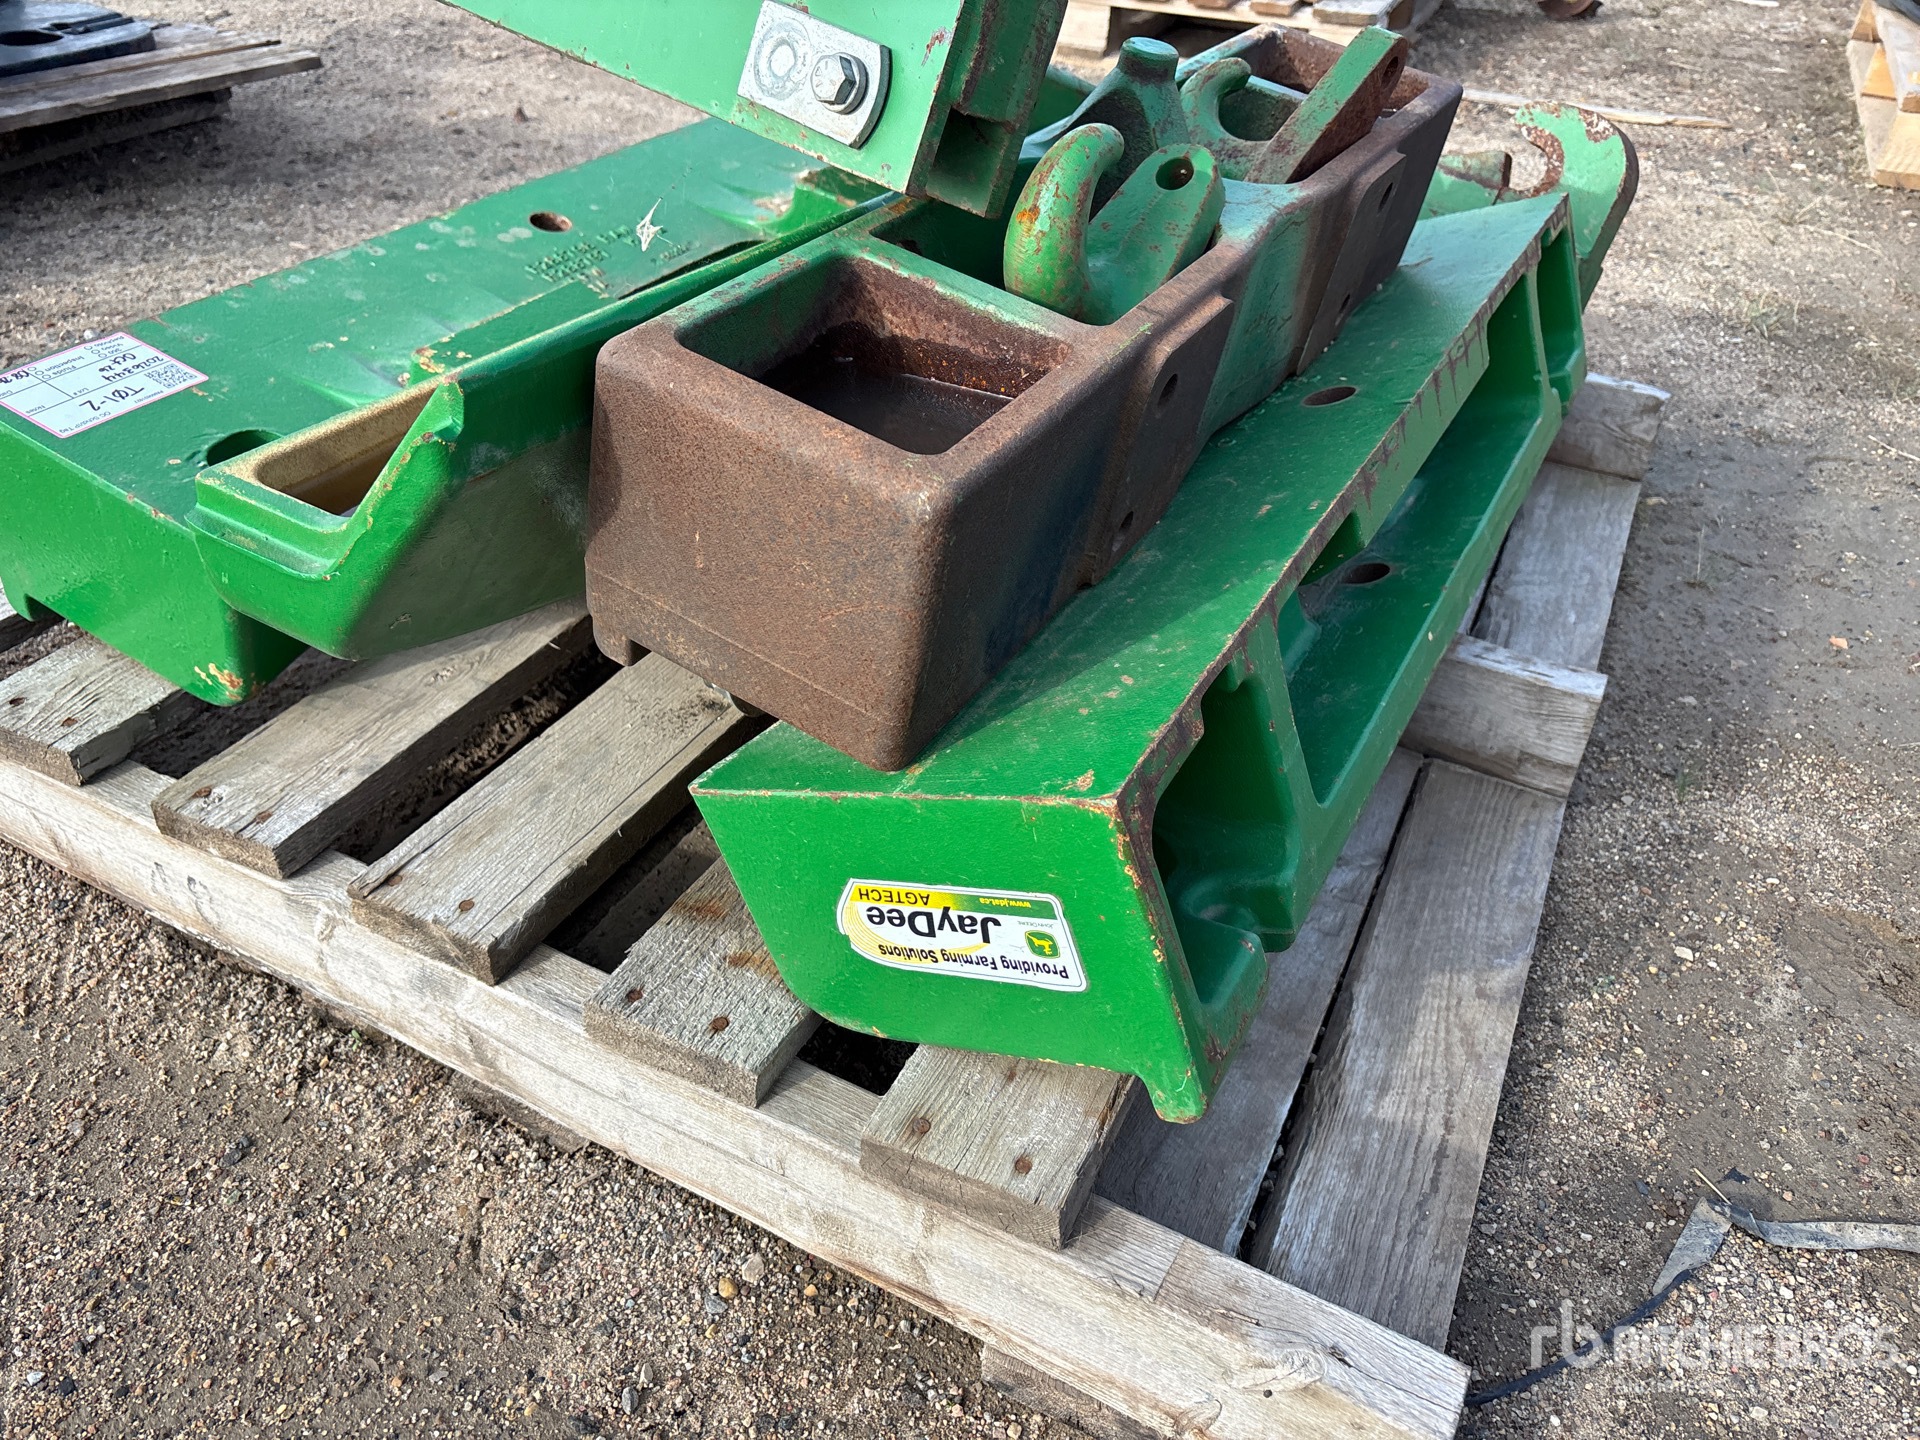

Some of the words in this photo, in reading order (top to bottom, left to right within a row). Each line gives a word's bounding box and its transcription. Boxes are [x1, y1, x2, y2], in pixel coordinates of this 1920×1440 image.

[45, 355, 84, 371] Inspection
[858, 887, 930, 906] AGTECH
[979, 896, 1031, 909] www.jdat.ca
[866, 905, 1002, 944] JayDee
[879, 943, 938, 964] Solutions
[943, 949, 998, 970] Farming
[1001, 956, 1069, 979] Providing
